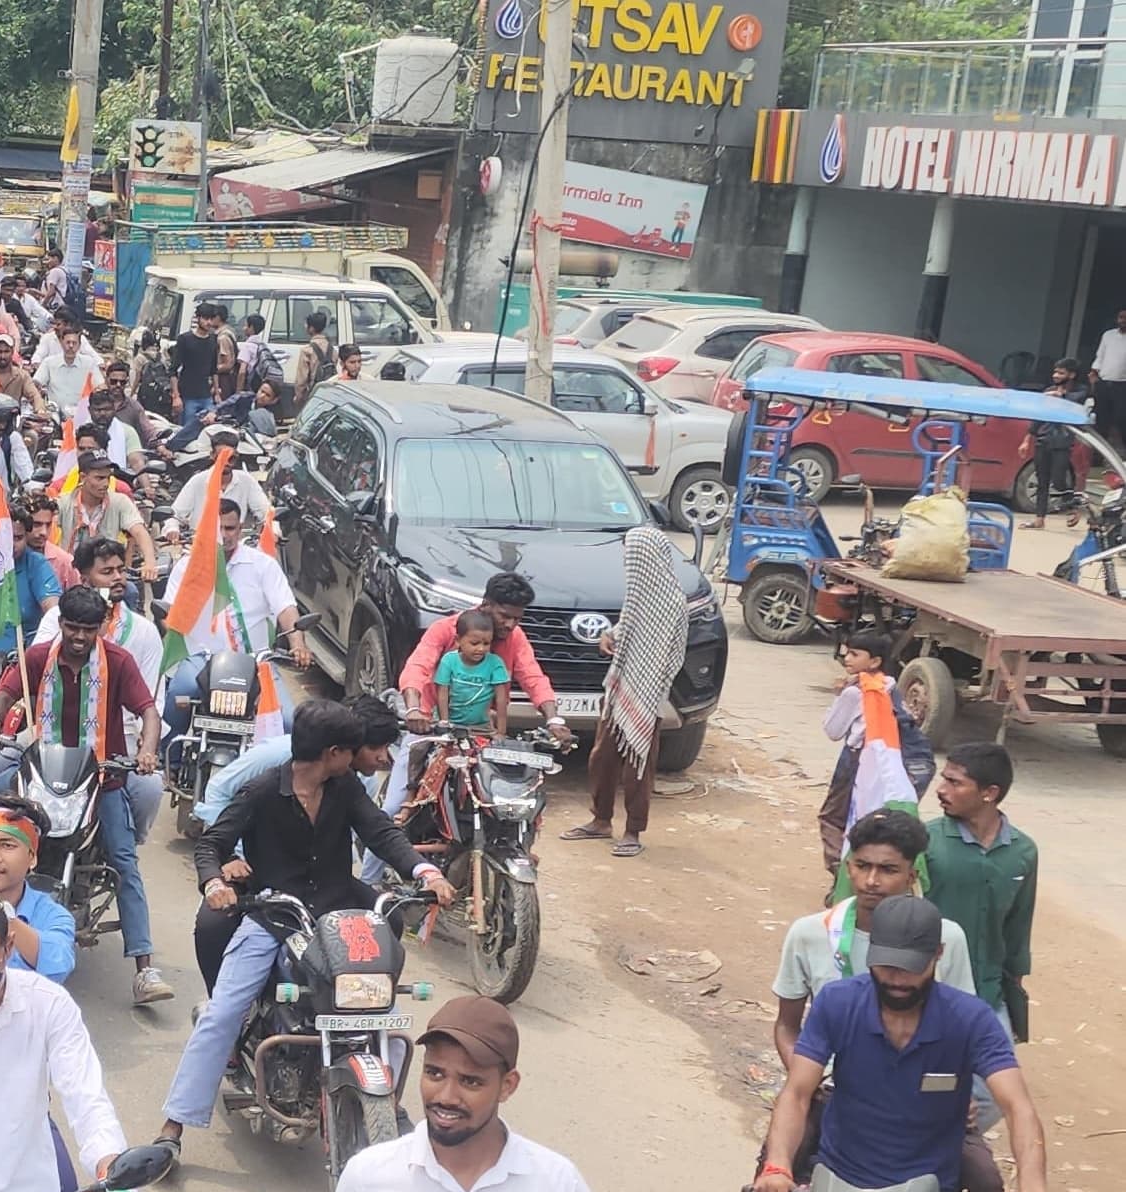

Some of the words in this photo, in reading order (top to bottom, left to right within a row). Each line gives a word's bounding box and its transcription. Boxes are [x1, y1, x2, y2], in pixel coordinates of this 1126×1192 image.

[538, 0, 723, 55] TSAV
[486, 52, 752, 107] RETAURANT
[860, 125, 954, 193] HOTEL
[953, 129, 1117, 206] NIRMALA
[562, 181, 612, 204] irmala
[617, 192, 643, 209] Inn
